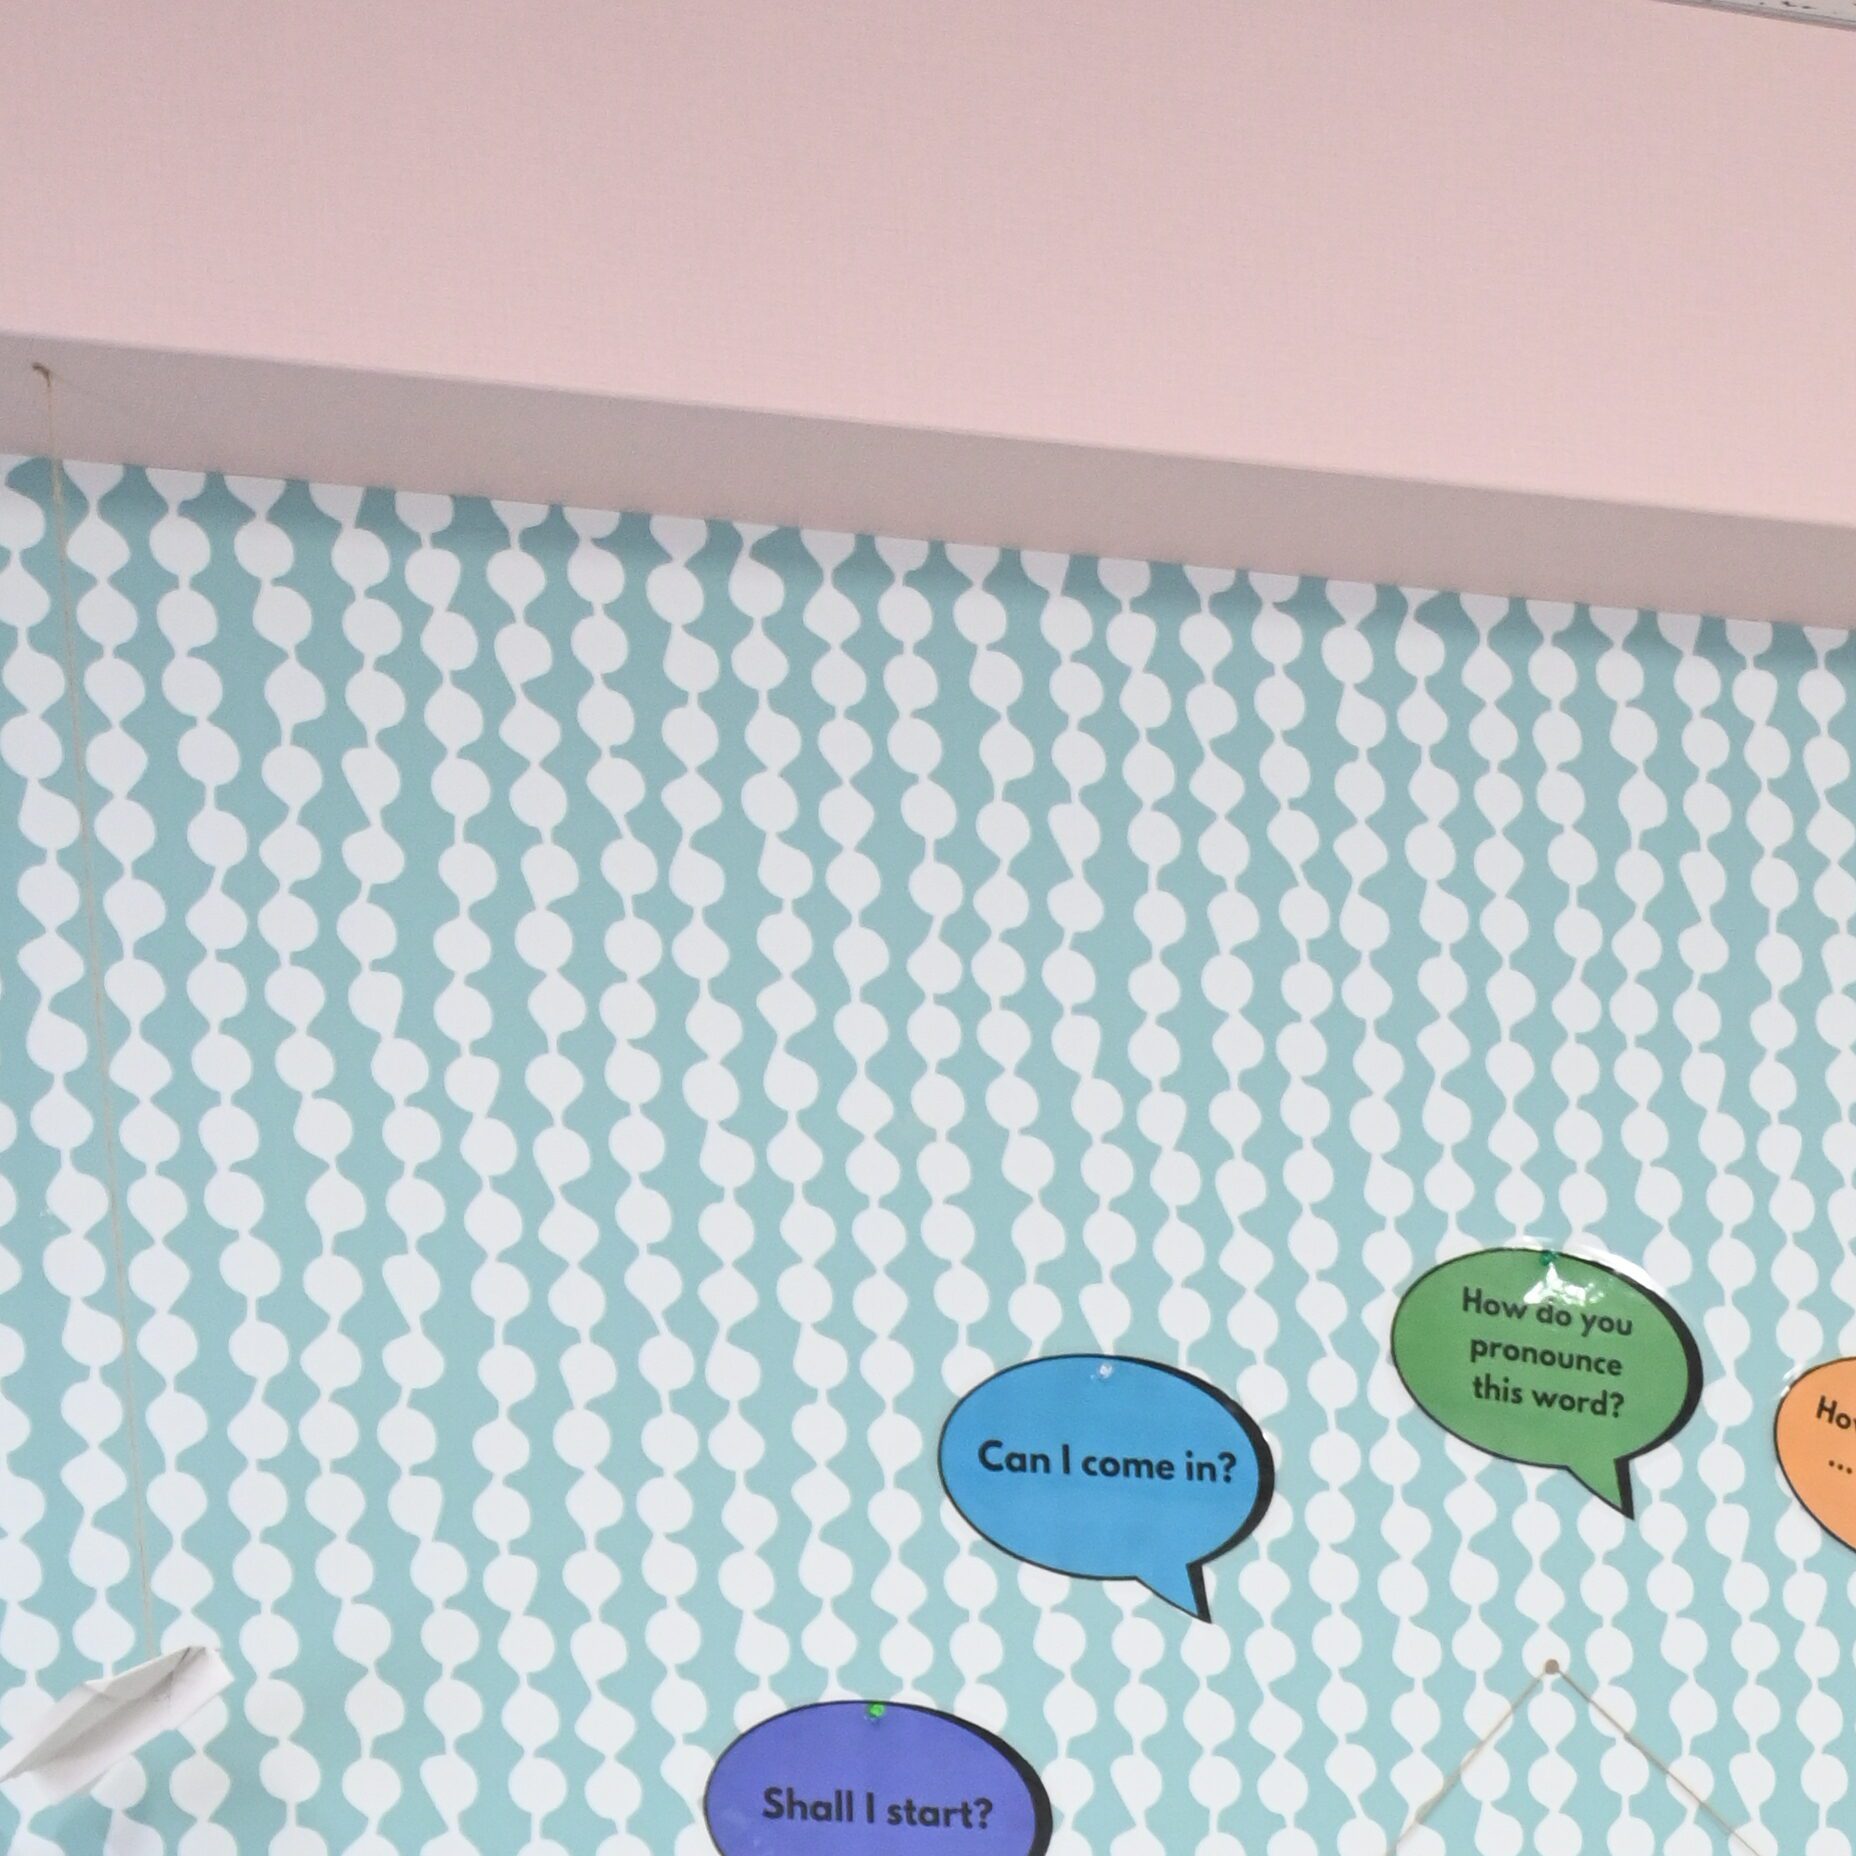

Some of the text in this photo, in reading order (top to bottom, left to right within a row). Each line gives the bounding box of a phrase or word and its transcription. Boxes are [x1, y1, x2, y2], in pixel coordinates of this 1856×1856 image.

[1462, 1286, 1633, 1338] How do you
[1470, 1338, 1623, 1377] pronounce
[1472, 1372, 1625, 1419] this word?
[977, 1439, 1237, 1484] Can I come in?
[761, 1786, 994, 1830] Shall I start?
